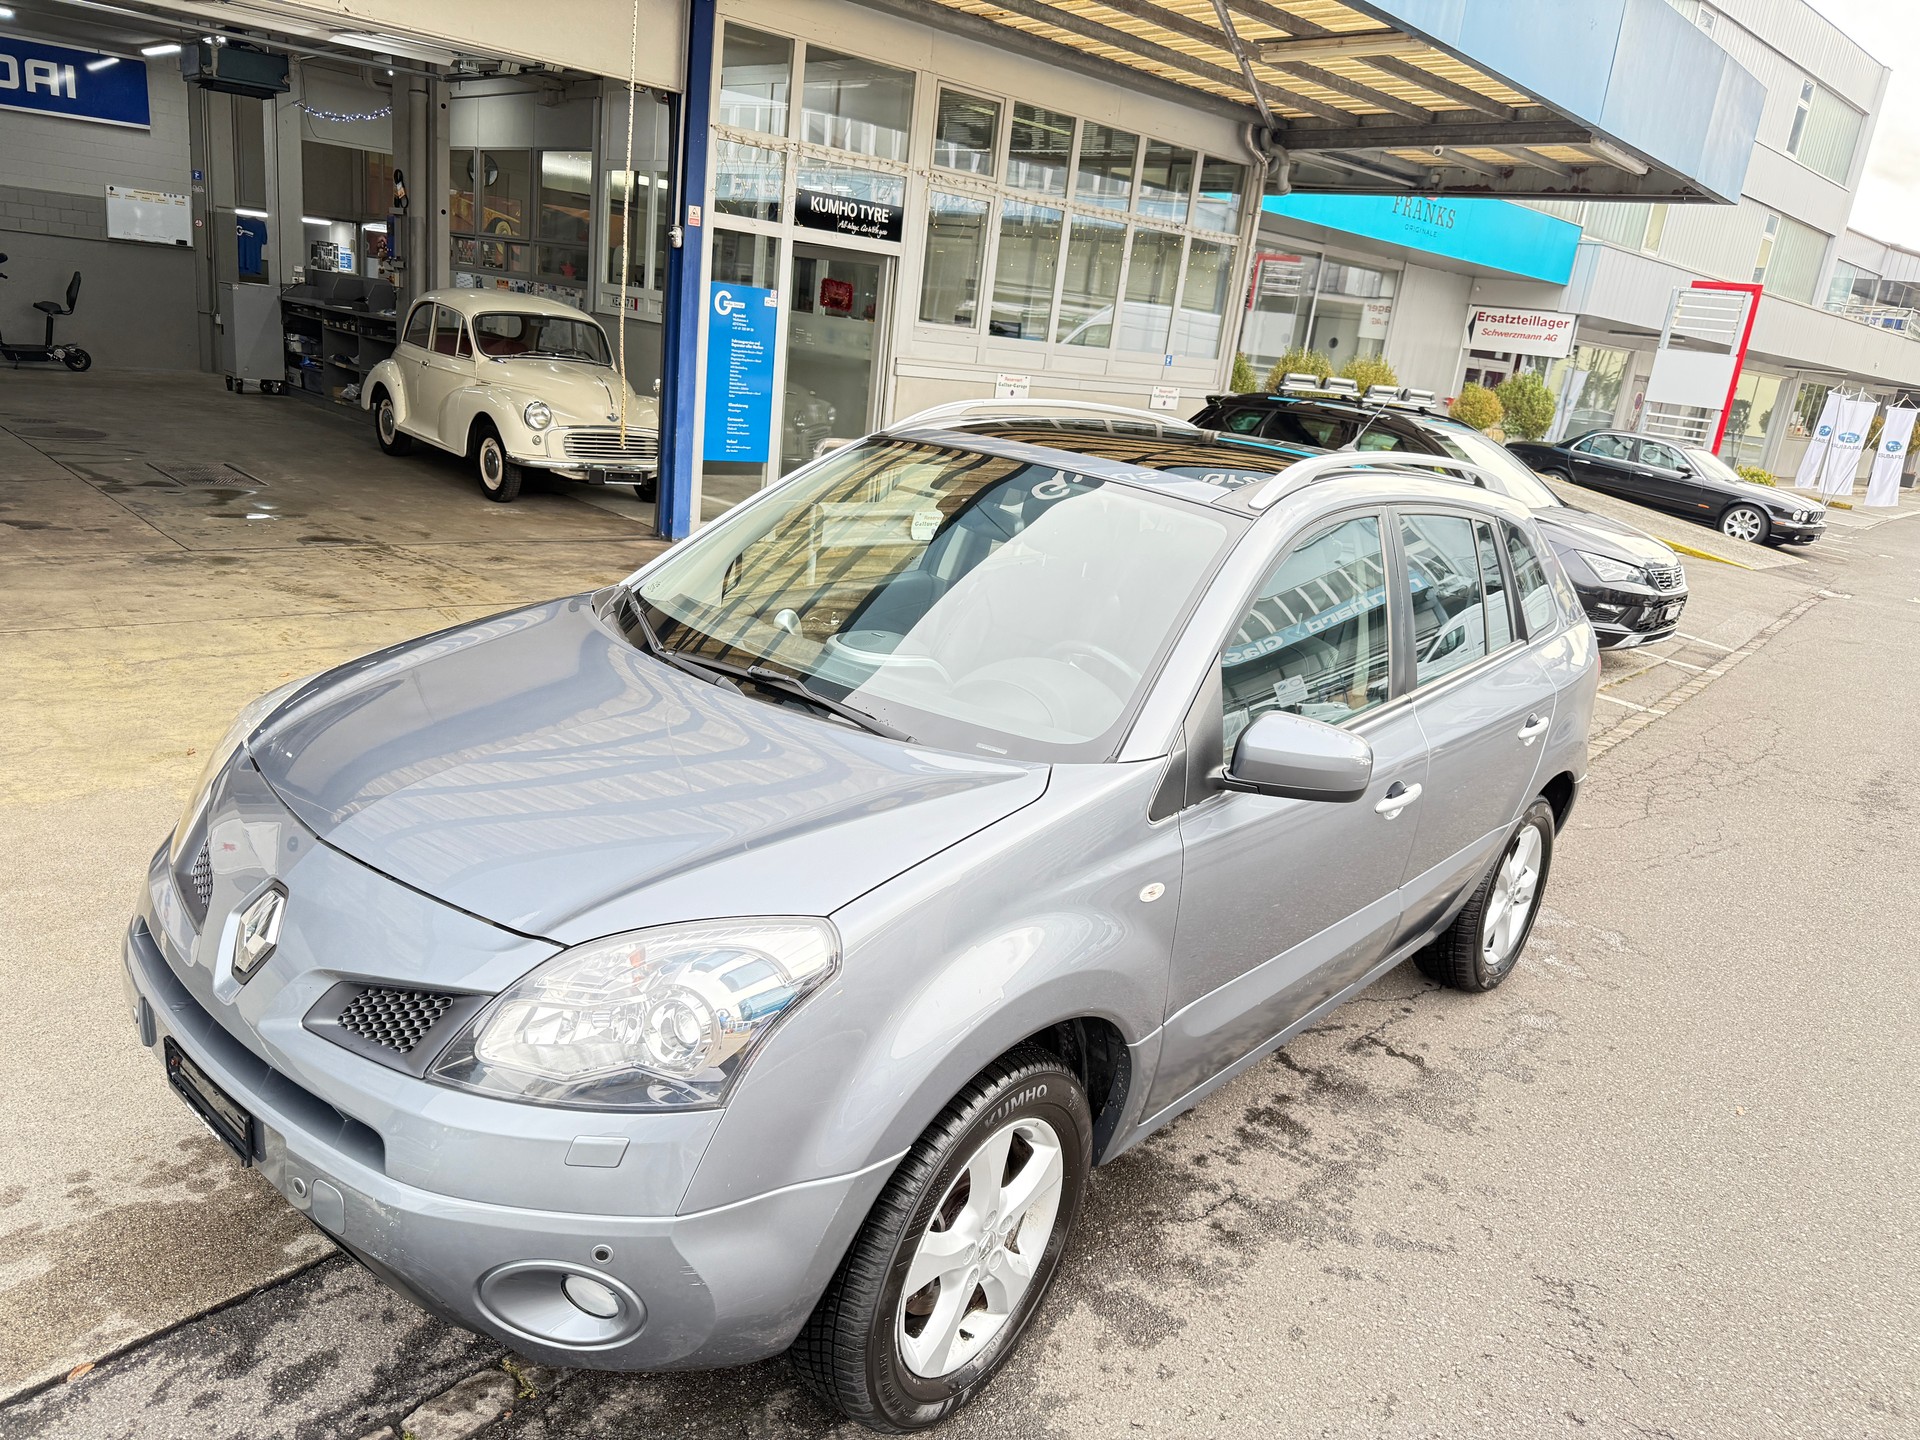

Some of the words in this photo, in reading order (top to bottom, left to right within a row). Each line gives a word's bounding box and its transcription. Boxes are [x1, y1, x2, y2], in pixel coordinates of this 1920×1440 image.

[811, 196, 858, 218] KUMHO
[859, 204, 890, 223] TYRE
[1392, 195, 1456, 229] FRANKS
[1476, 311, 1571, 330] Ersatzteillager
[1480, 328, 1542, 341] Schwerzmann
[1543, 333, 1558, 342] AG
[984, 1084, 1048, 1128] KUMHO
